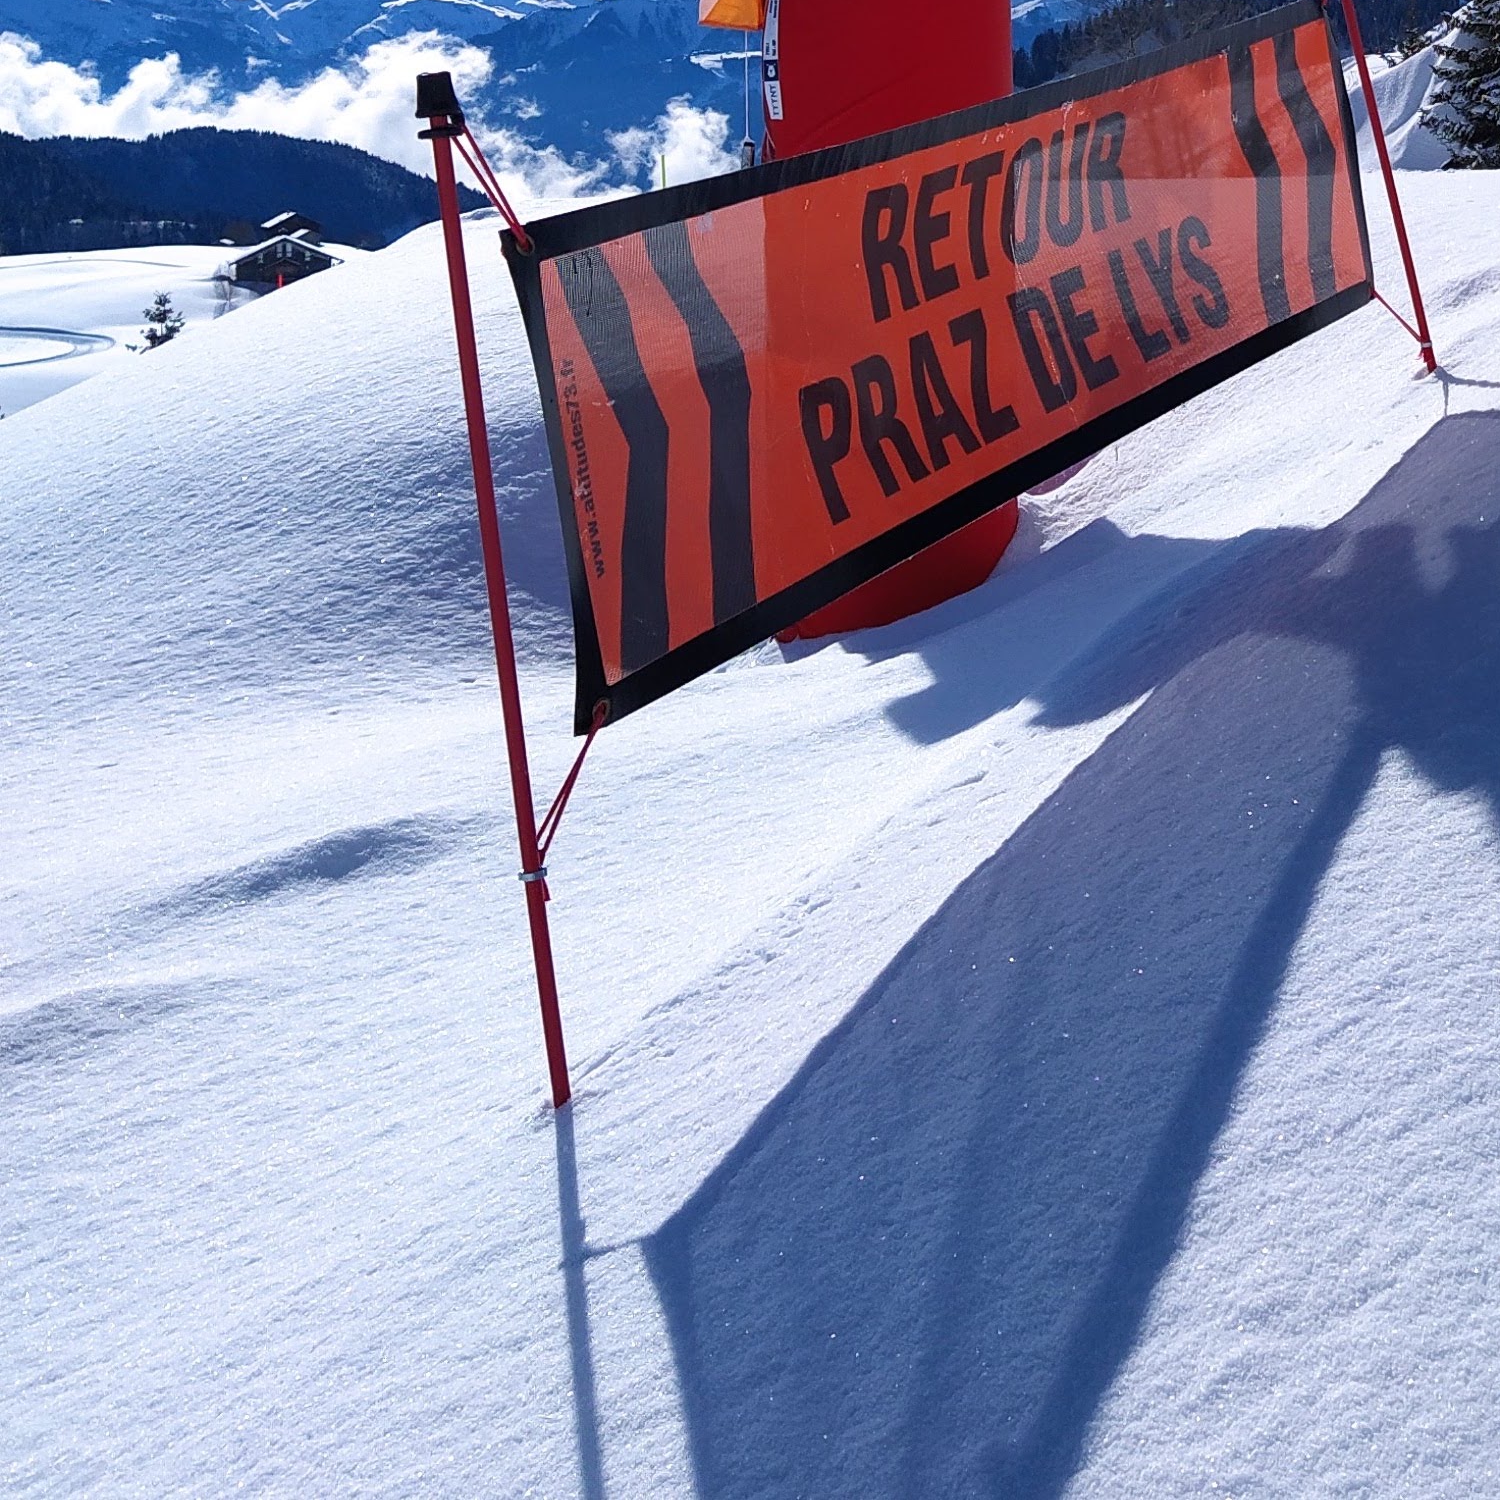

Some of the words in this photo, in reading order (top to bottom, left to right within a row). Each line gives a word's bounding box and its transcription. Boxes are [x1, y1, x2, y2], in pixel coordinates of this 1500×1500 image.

[861, 110, 1133, 324] RETOUR
[799, 308, 1020, 526] PRAZ
[1006, 267, 1120, 415] DE
[1108, 215, 1231, 363] LYS
